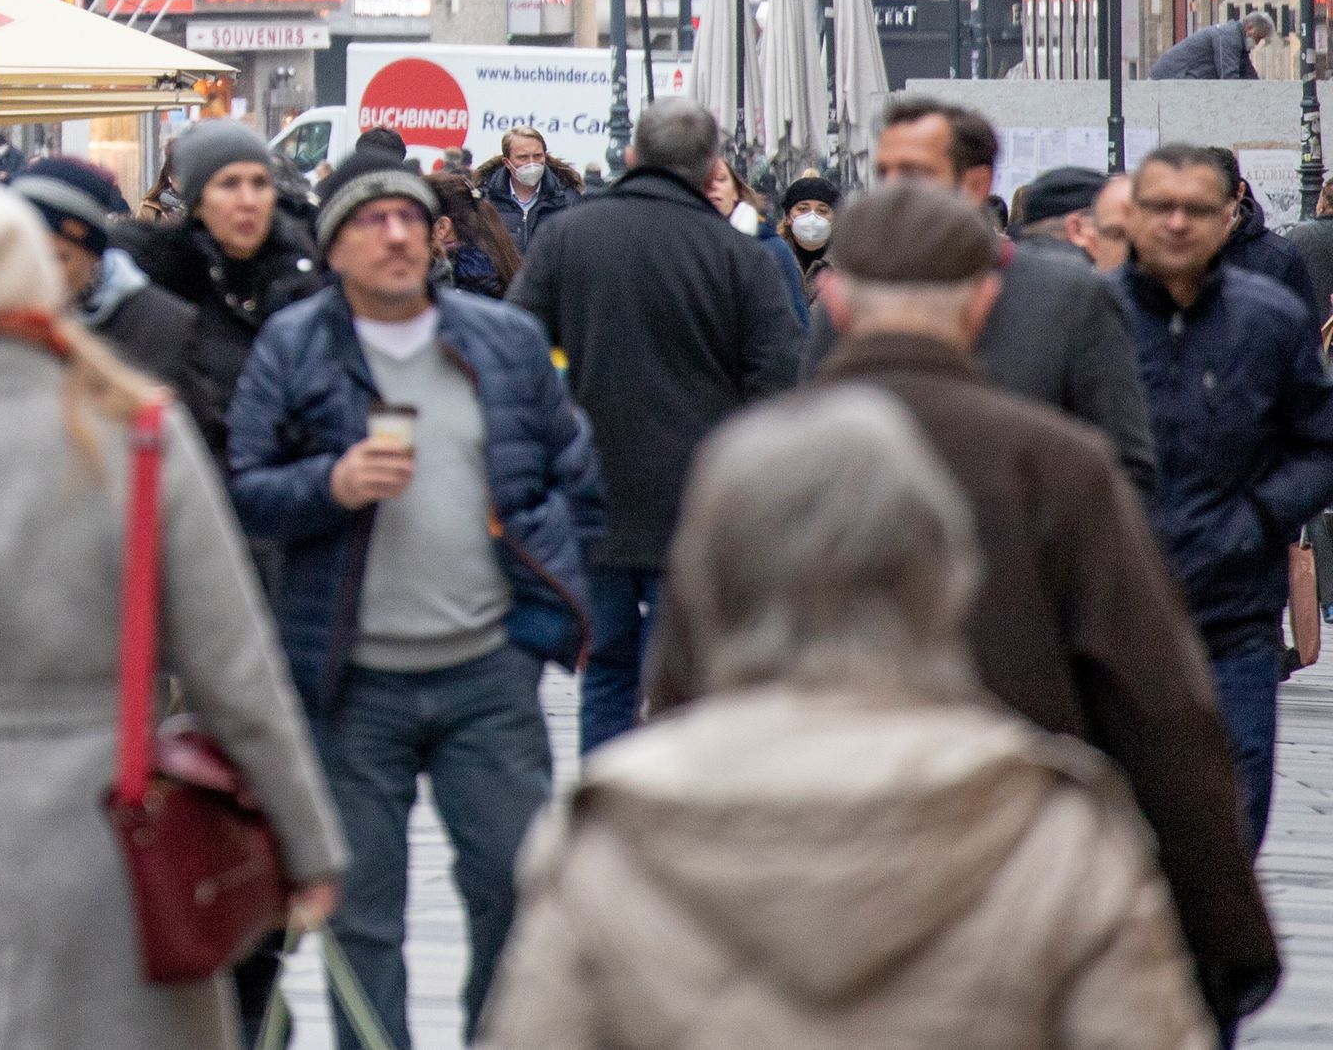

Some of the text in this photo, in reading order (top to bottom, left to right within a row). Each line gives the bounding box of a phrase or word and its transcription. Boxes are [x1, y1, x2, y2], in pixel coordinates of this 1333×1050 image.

[212, 25, 304, 47] SOUVENIRS
[476, 65, 610, 85] www.buchbinder.co.
[360, 106, 469, 129] BUCHBINDER
